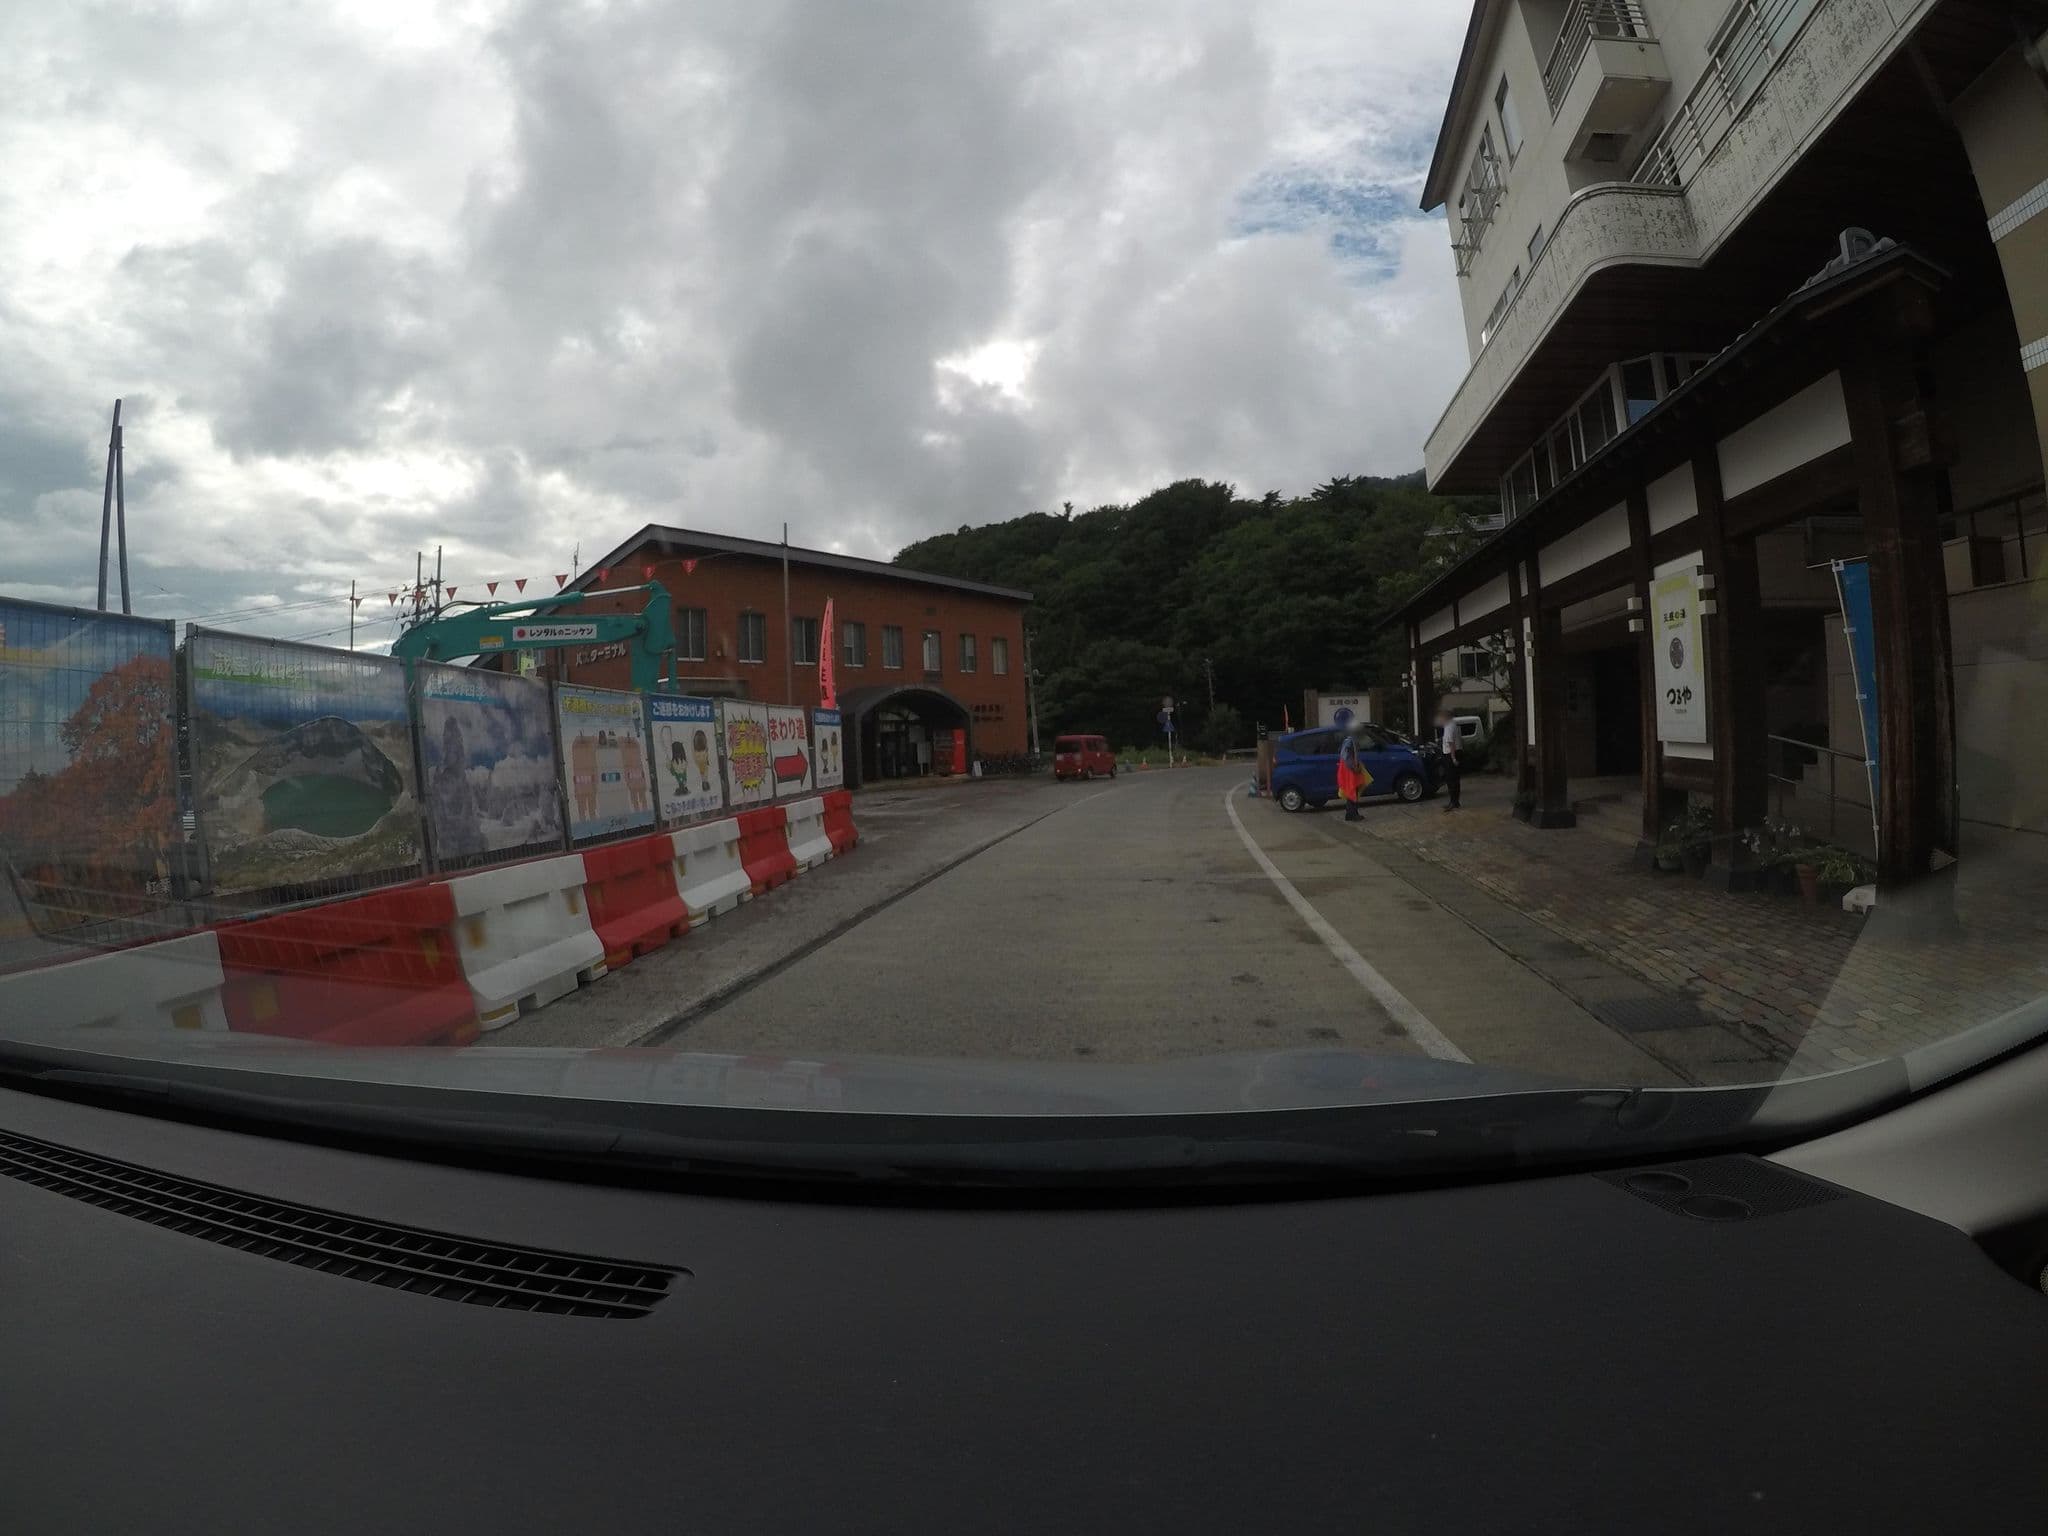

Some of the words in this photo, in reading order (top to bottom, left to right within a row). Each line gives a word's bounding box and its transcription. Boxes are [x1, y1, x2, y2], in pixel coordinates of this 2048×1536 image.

[529, 627, 593, 638] レンタルのニッケン
[1667, 685, 1692, 705] つるや
[769, 717, 805, 741] まわり道
